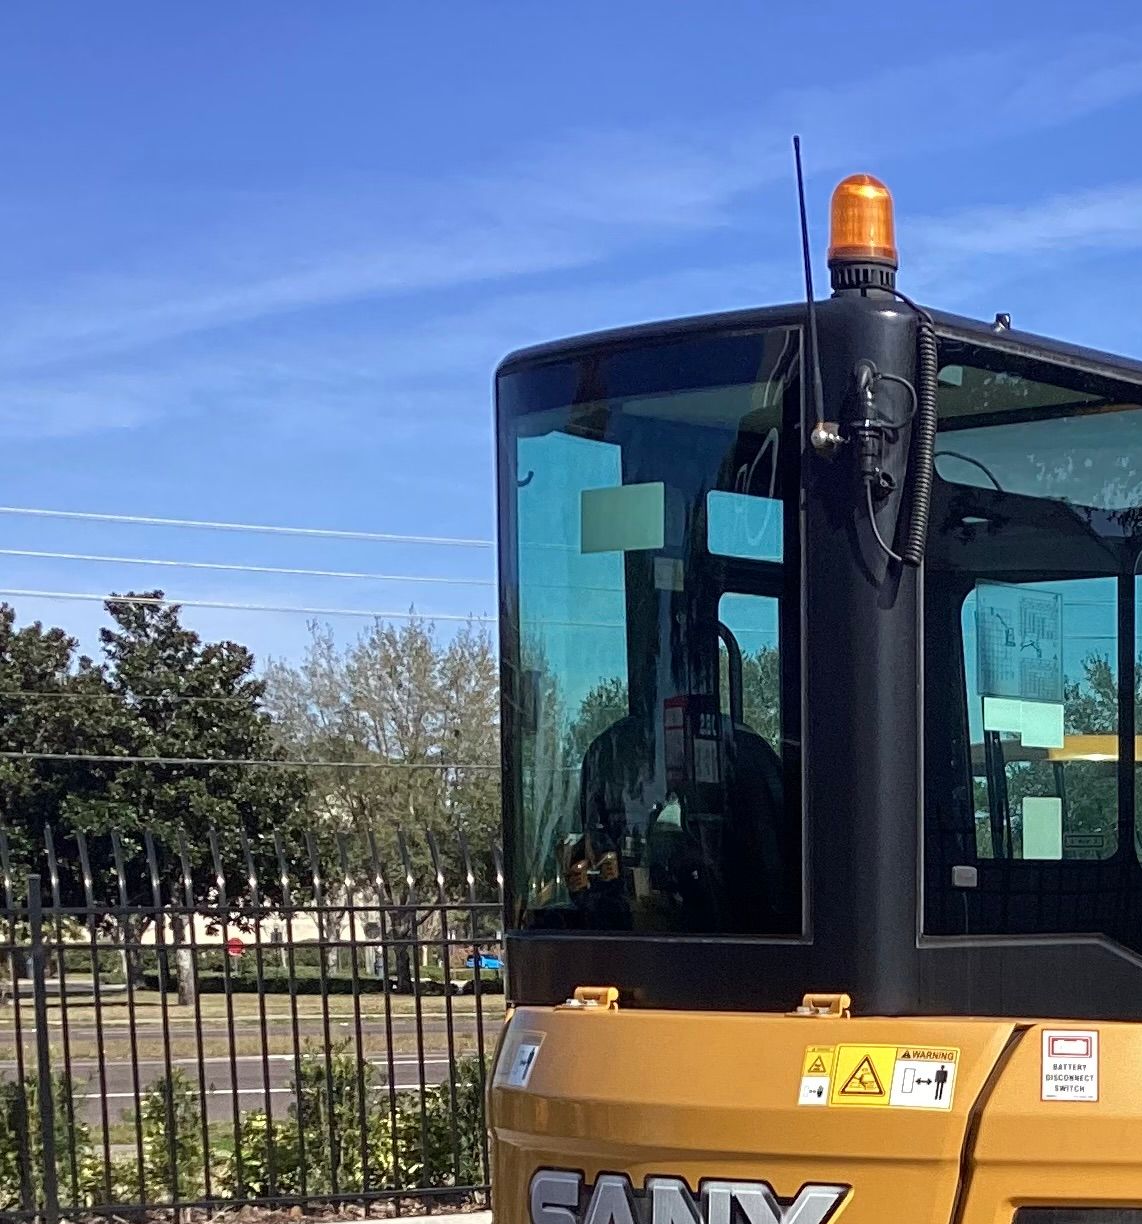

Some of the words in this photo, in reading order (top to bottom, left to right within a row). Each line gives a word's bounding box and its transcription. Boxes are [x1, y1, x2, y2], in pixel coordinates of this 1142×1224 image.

[911, 1050, 954, 1061] WARNING
[1052, 1063, 1087, 1071] BATTERY
[1045, 1074, 1094, 1082] DISCONNECT
